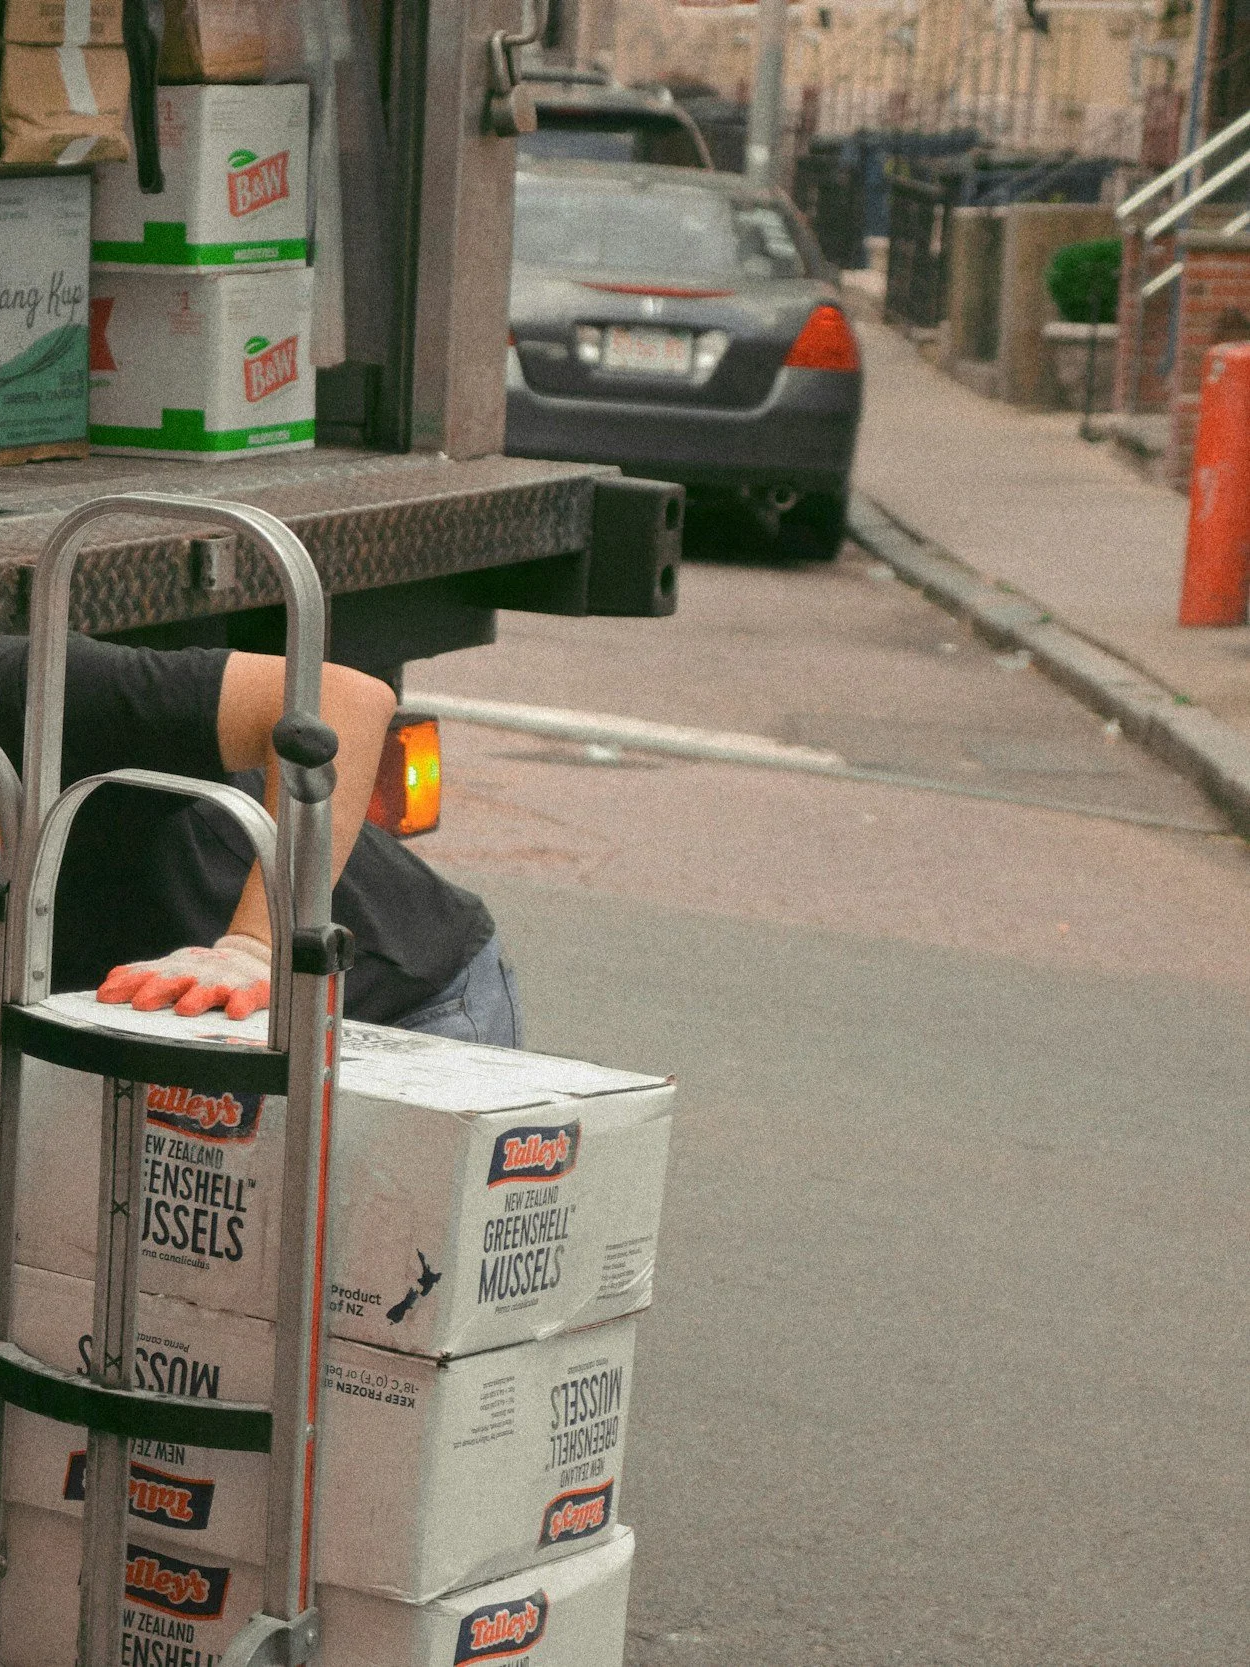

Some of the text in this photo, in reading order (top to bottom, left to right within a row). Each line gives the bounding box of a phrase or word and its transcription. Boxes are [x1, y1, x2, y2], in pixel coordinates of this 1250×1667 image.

[236, 158, 284, 213] B&W
[47, 271, 83, 325] Kup
[250, 343, 295, 399] B&W
[147, 1083, 243, 1129] alley's
[168, 1139, 224, 1170] ZEALAND
[503, 1130, 570, 1170] Talley's
[505, 1186, 559, 1212] NEW ZEALAND
[159, 1251, 210, 1270] canaliculus
[478, 1244, 565, 1304] MUSSELS
[330, 1299, 364, 1316] of NZ
[331, 1284, 381, 1305] Product
[164, 1340, 190, 1353] Perna
[347, 1370, 358, 1379] or
[336, 1382, 382, 1401] FROZEN
[385, 1394, 415, 1408] KEEP
[550, 1365, 622, 1430] MUSSELS
[155, 1443, 185, 1465] NEW
[561, 1457, 605, 1488] NEW ZEALAND
[550, 1496, 605, 1541] Talley's
[138, 1612, 194, 1643] ZEALAND
[471, 1601, 539, 1650] Talley's
